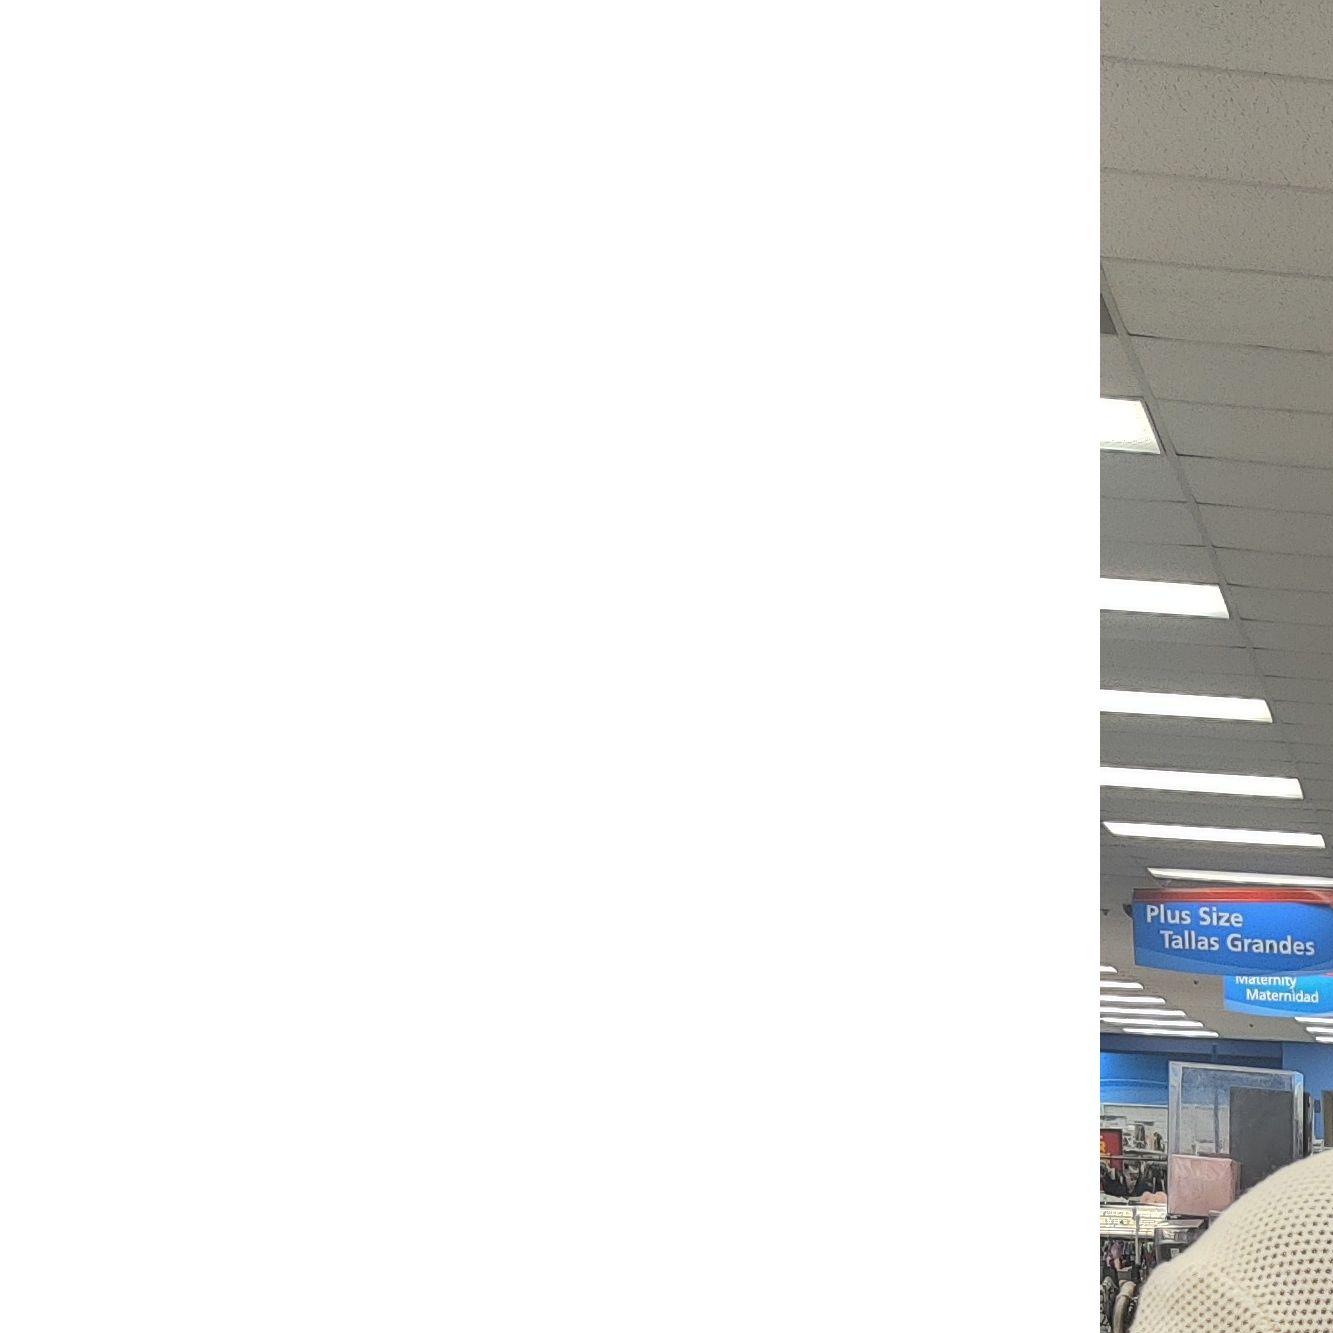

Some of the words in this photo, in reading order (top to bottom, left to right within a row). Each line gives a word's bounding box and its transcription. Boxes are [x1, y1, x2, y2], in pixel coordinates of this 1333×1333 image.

[1145, 904, 1191, 925] Plus
[1198, 905, 1244, 928] Size
[1159, 930, 1220, 951] Tallas
[1226, 933, 1315, 956] Grandes
[1246, 988, 1319, 1004] Maternidad
